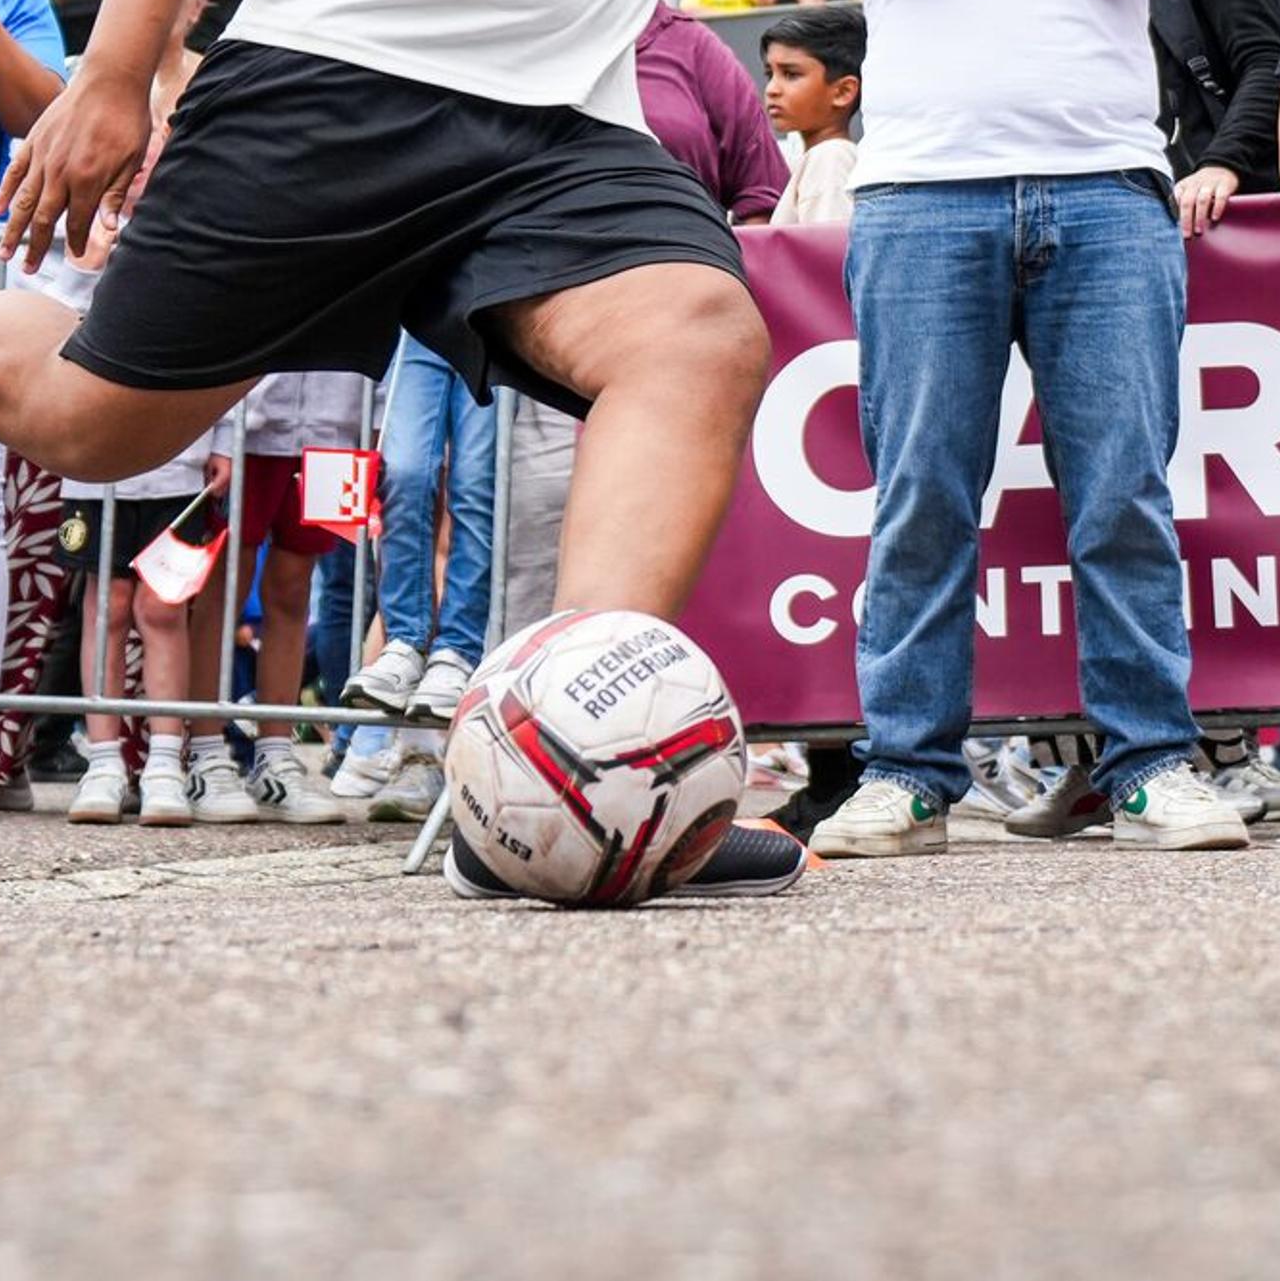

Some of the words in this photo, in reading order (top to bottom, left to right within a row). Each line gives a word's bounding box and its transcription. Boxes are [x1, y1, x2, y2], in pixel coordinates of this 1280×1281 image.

[563, 627, 672, 703] FEYENOORD
[582, 643, 691, 720] ROTTERDAM
[461, 783, 489, 829] 1908
[496, 827, 532, 861] EST.
